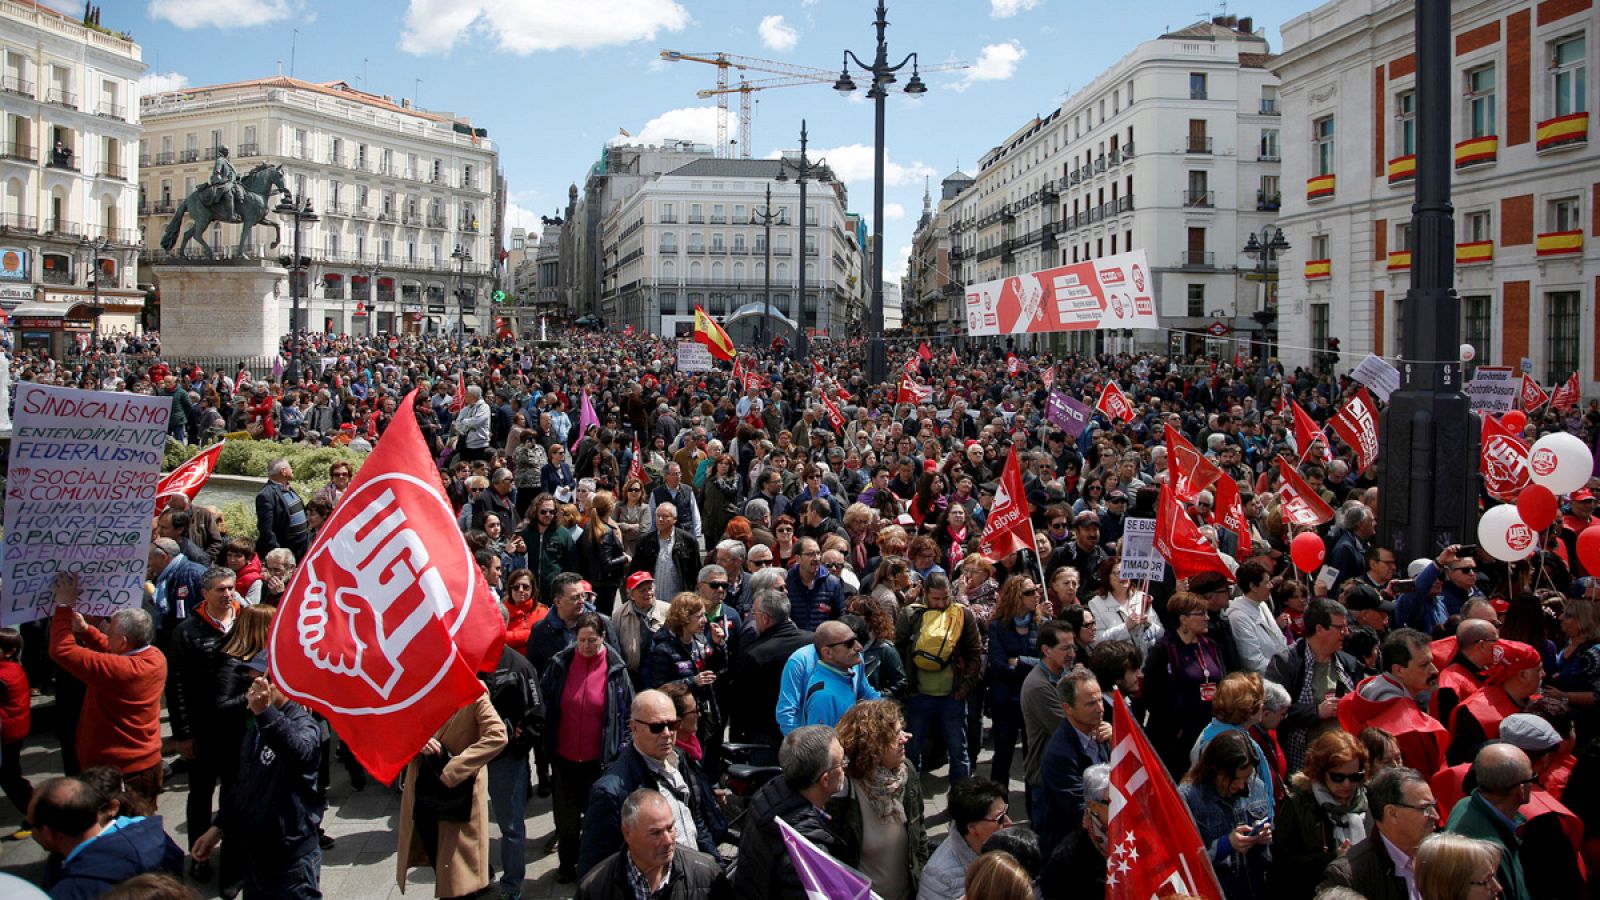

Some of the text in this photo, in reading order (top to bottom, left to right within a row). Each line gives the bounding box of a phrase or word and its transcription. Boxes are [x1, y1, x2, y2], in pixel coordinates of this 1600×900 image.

[15, 442, 161, 465] FEDERALISMO.
[1488, 437, 1528, 478] UGT
[1534, 450, 1555, 469] UGT
[13, 515, 151, 530] HONRADEZ.
[1127, 519, 1157, 532] SE BUS
[1509, 525, 1531, 542] UGT
[329, 487, 455, 662] UGT
[1135, 572, 1161, 580] seie.
[12, 588, 131, 612] LIBTAD.
